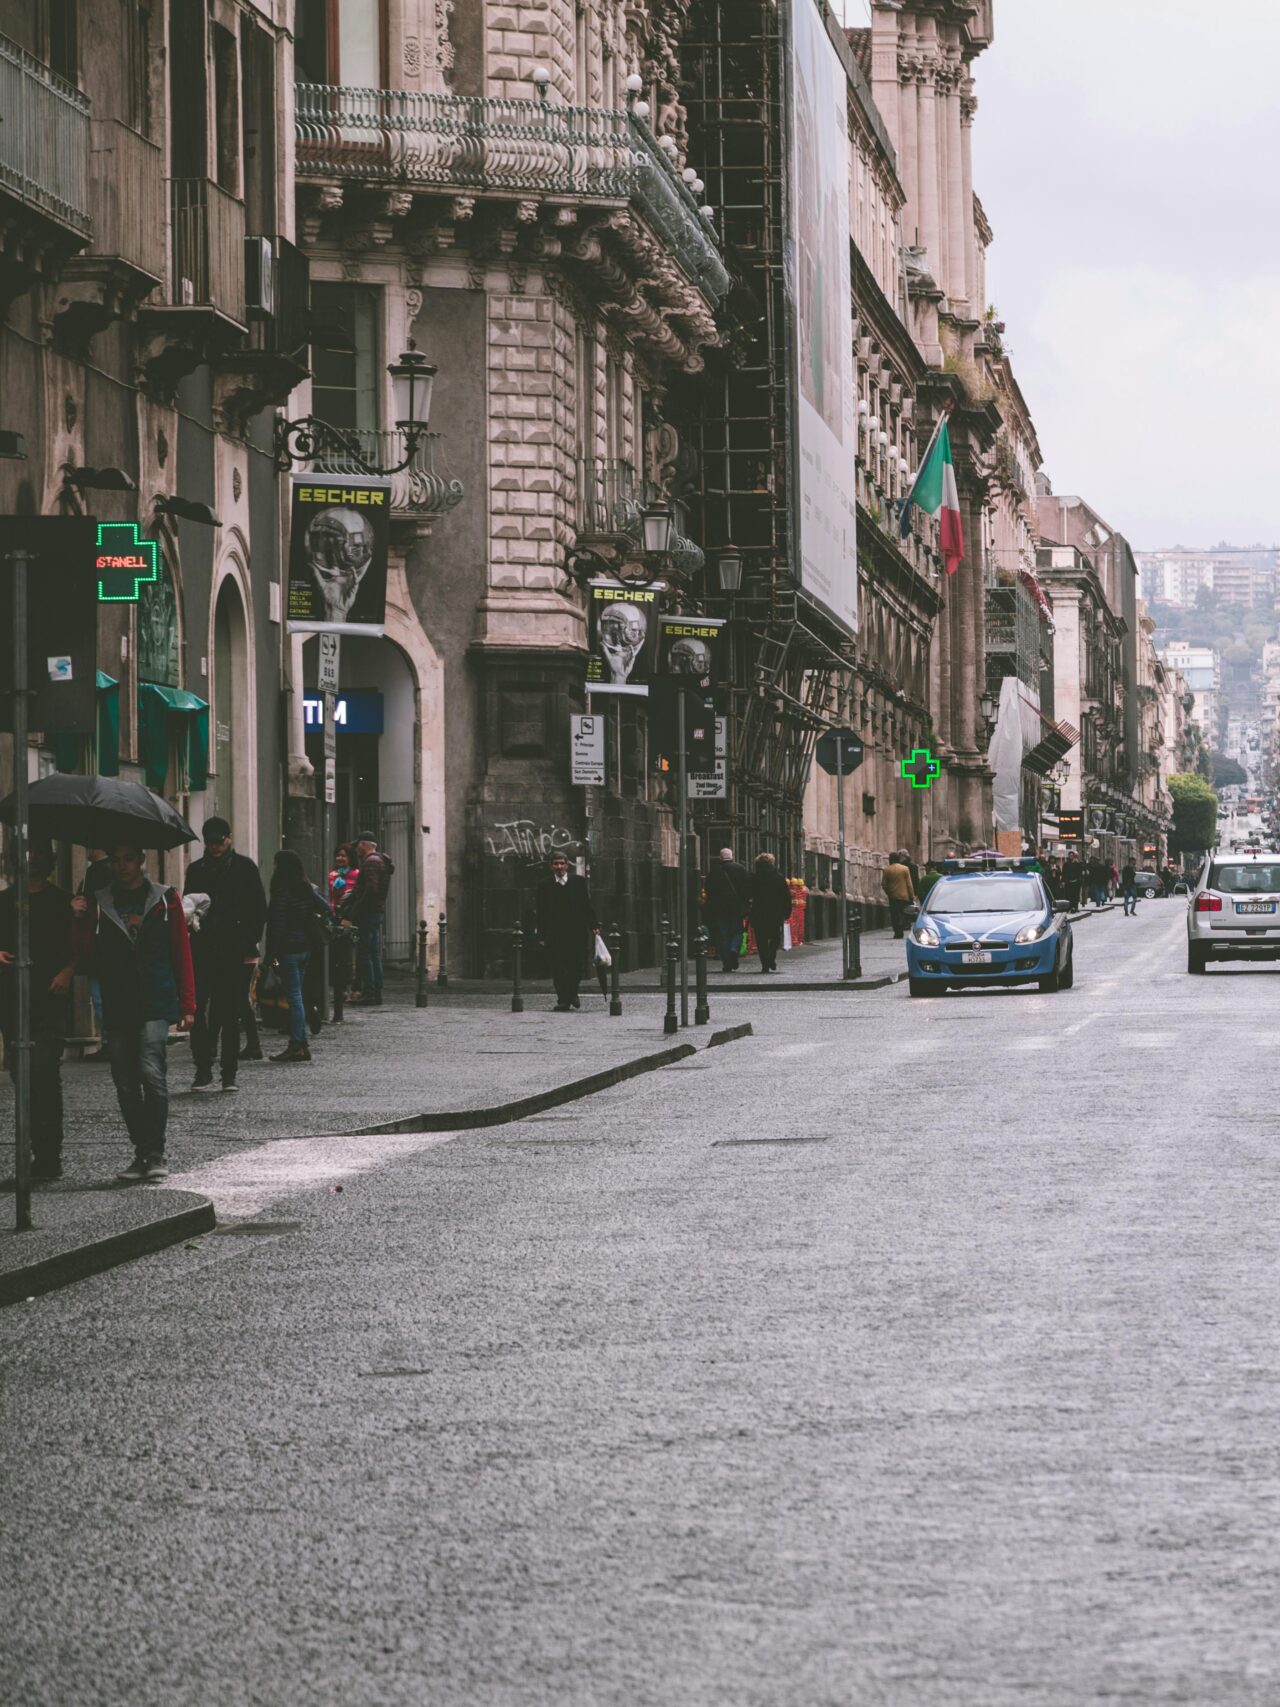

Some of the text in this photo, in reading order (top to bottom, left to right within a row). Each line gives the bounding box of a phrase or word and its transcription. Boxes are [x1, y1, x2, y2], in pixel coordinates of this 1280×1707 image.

[299, 488, 384, 505] ESCHER
[594, 589, 655, 602] ESCHER
[666, 625, 718, 638] ESCHER
[303, 700, 347, 724] TIM
